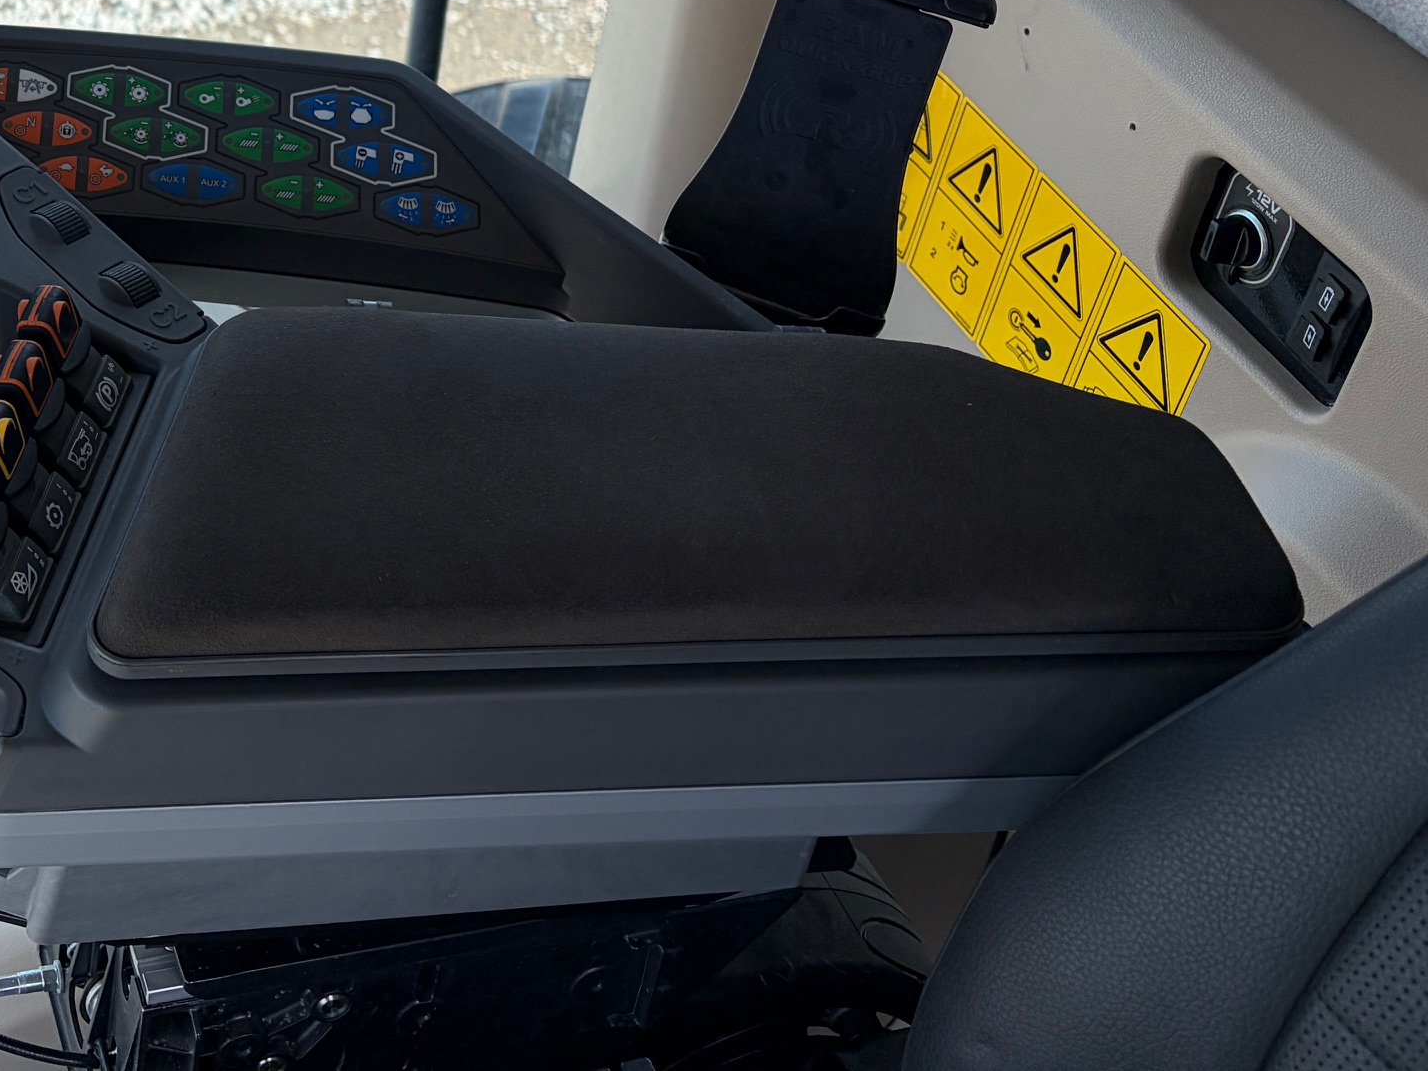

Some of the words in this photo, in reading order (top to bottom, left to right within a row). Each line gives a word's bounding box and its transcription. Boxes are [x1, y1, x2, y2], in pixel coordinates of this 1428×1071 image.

[25, 116, 37, 128] N
[160, 174, 179, 184] AUX
[181, 176, 187, 184] 1
[200, 177, 219, 187] AUX
[220, 179, 227, 189] 2
[12, 180, 49, 204] C1
[1256, 189, 1282, 215] 12V
[1265, 210, 1278, 225] MAX
[940, 220, 946, 231] 1
[929, 247, 938, 259] 2
[149, 301, 188, 329] C2
